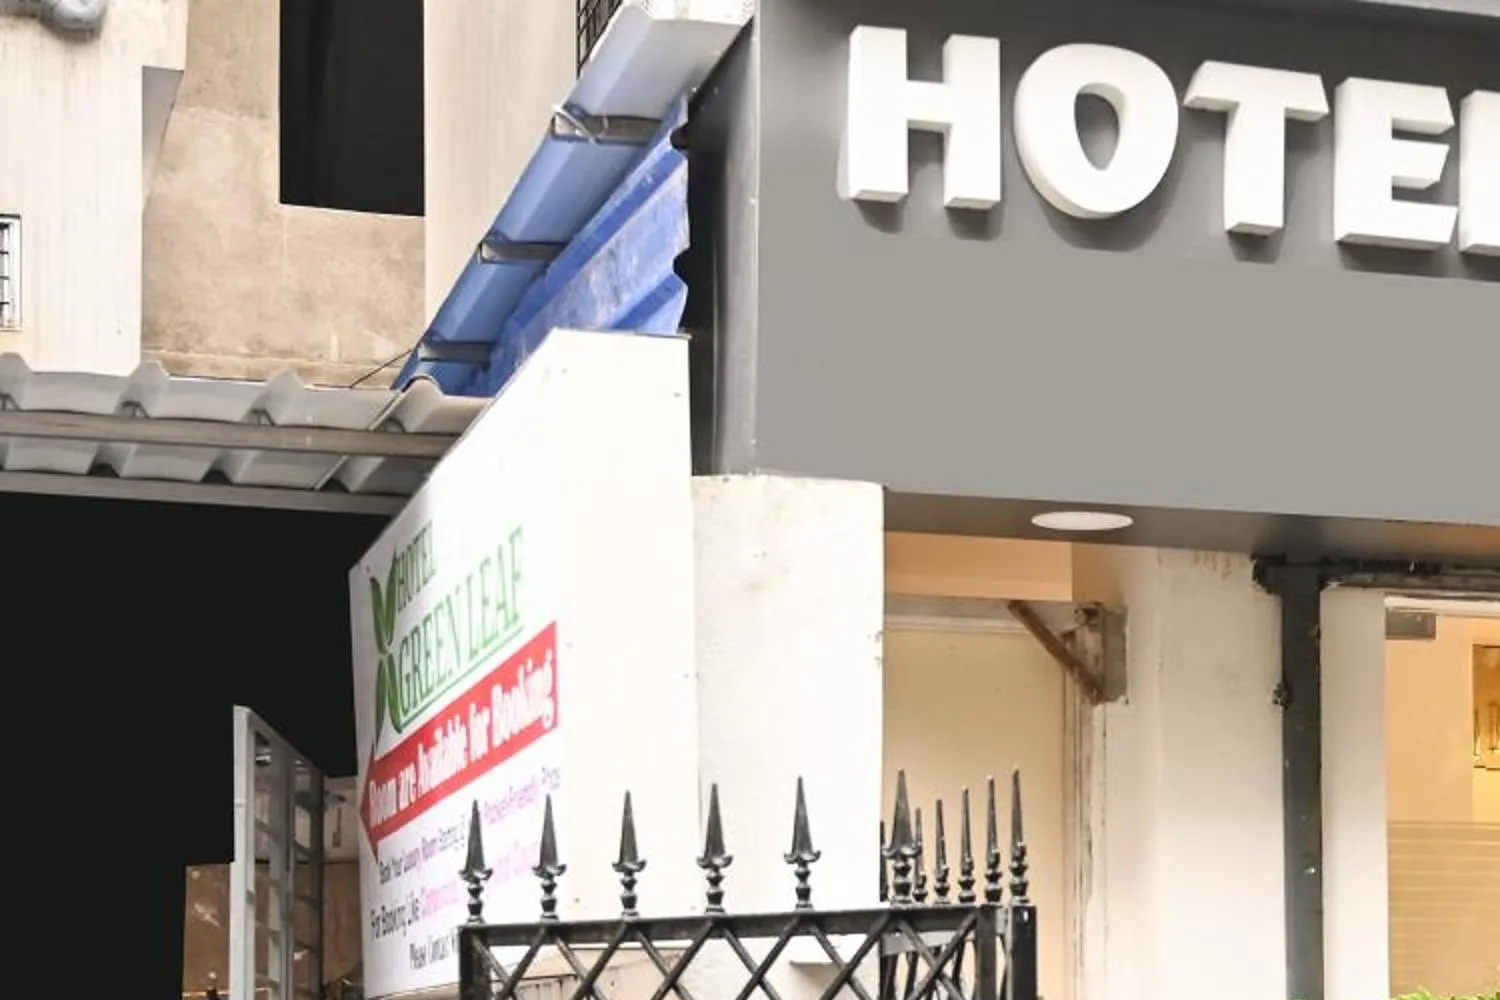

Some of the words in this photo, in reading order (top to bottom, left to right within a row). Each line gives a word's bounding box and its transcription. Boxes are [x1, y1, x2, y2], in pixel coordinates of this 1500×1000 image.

[397, 521, 436, 612] HOTEL
[400, 584, 462, 713] GREEN
[464, 523, 523, 661] LEAF
[468, 702, 490, 763] for
[490, 647, 554, 749] Booking
